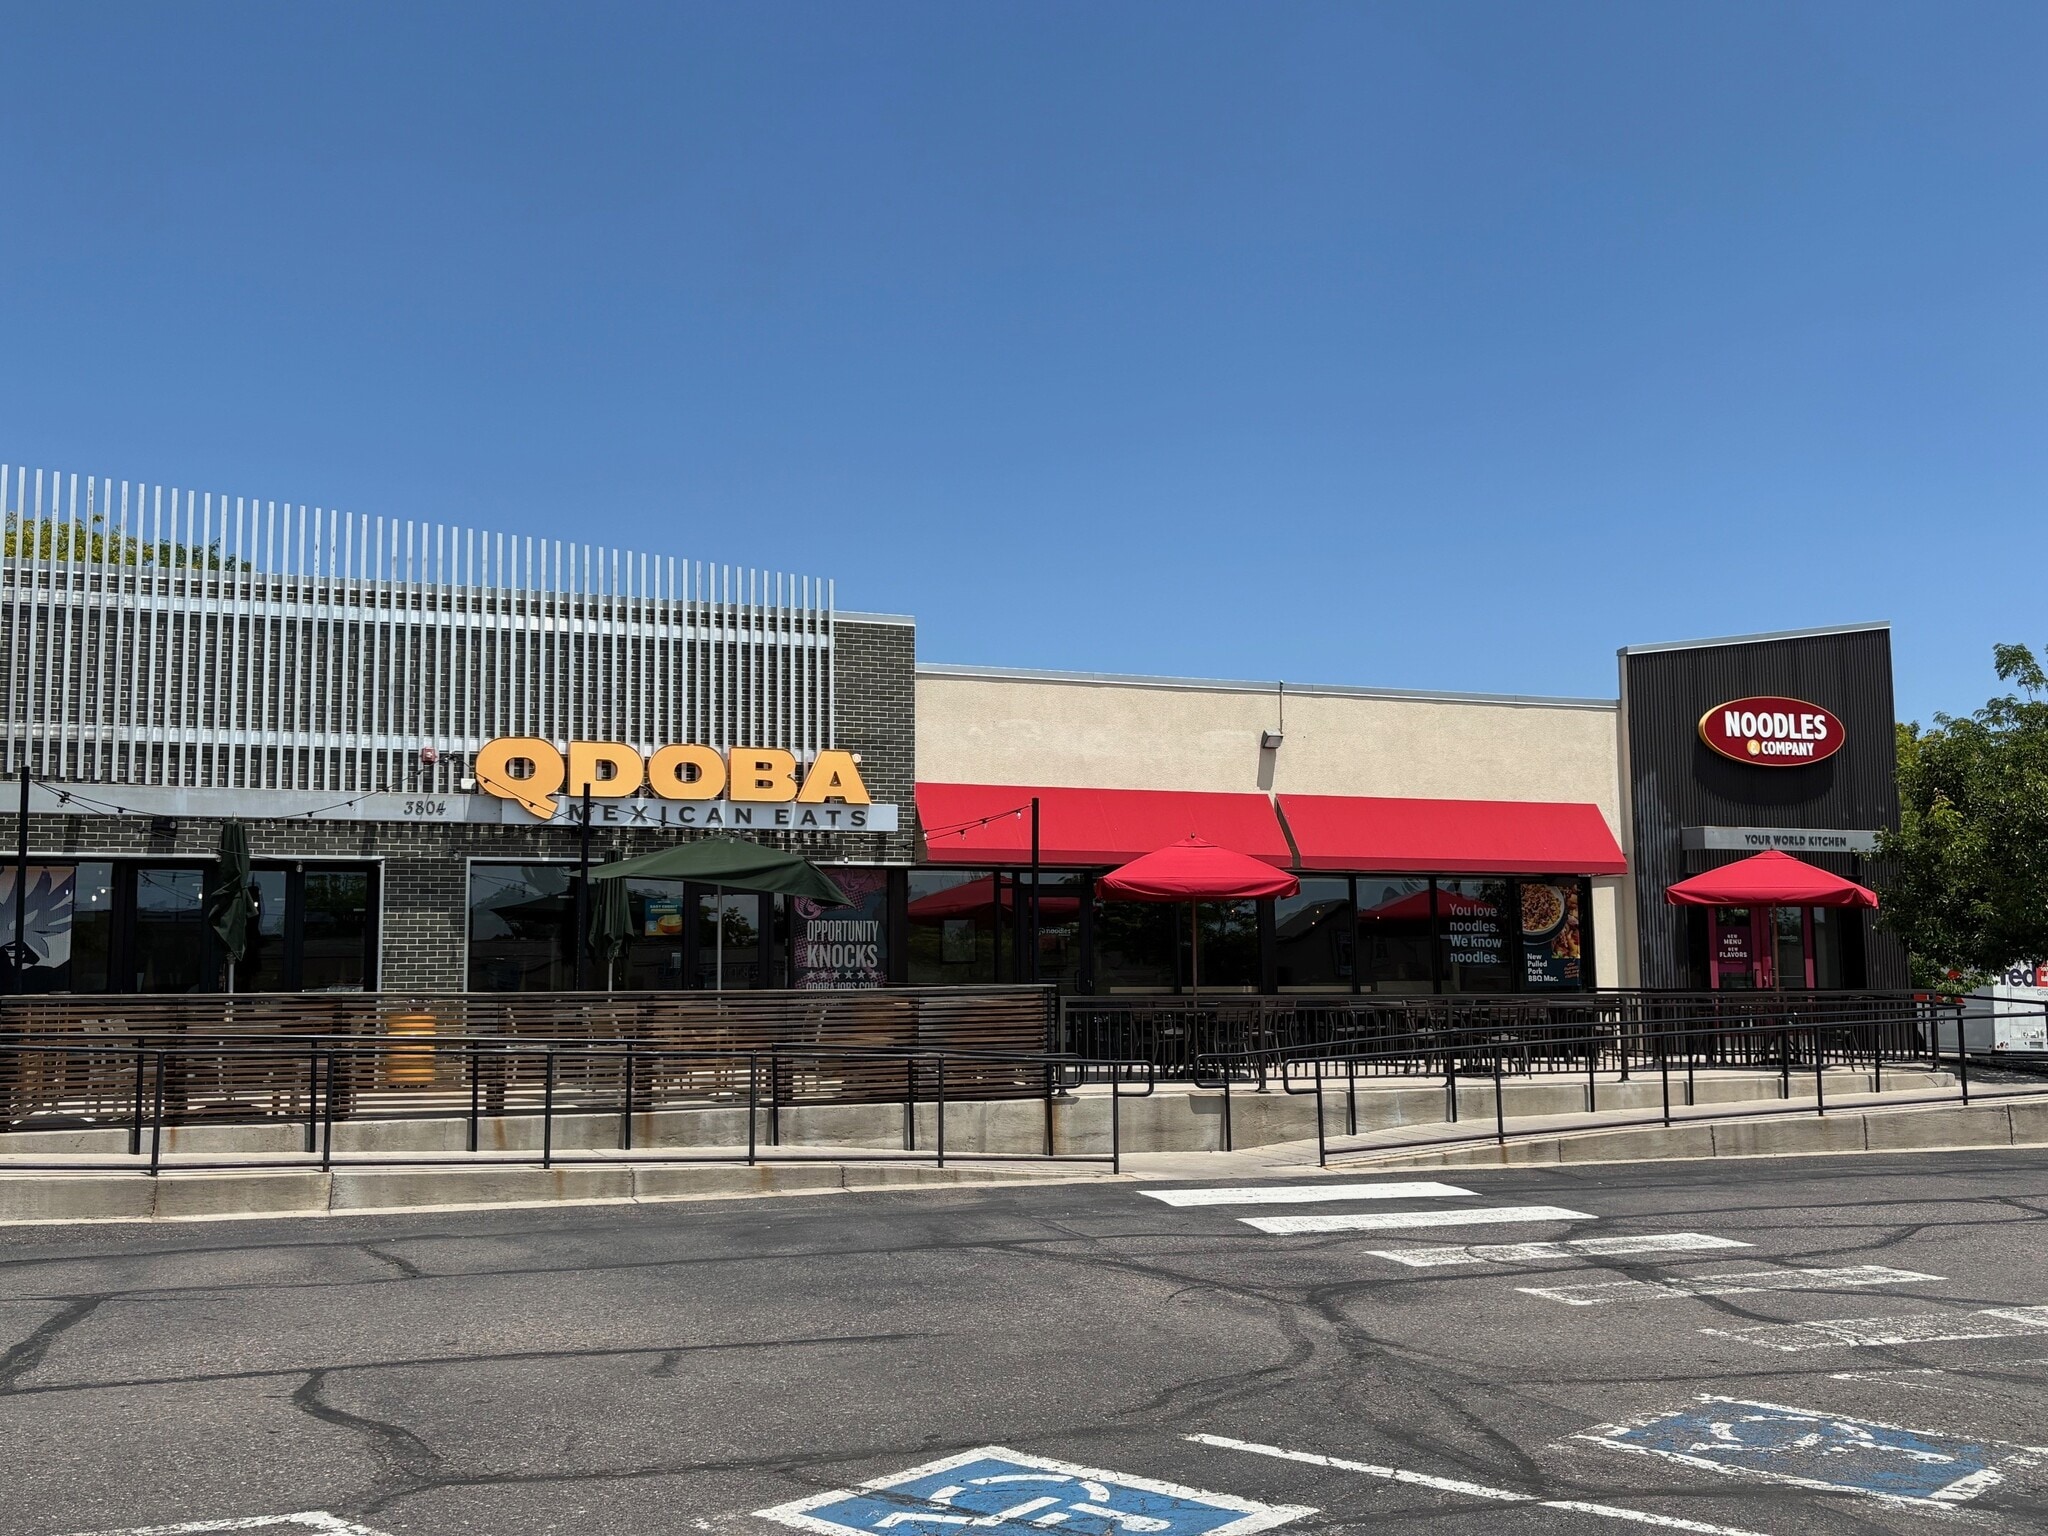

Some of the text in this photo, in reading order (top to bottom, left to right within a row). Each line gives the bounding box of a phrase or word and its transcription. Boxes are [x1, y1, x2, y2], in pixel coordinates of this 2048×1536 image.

[1725, 711, 1827, 740] NOODLES
[1761, 741, 1814, 756] COMPANY
[475, 737, 871, 819] QDOBA
[404, 801, 446, 815] 3804
[569, 805, 867, 827] MEXICAN EATS
[1745, 835, 1847, 847] YOUR WORLD KITCHEN
[1449, 904, 1498, 917] You love
[807, 920, 879, 942] OPPORTUNITY
[1450, 920, 1499, 932] noodles.
[1450, 935, 1502, 948] We know
[807, 944, 878, 968] KNOCKS
[1450, 951, 1500, 964] noodles.
